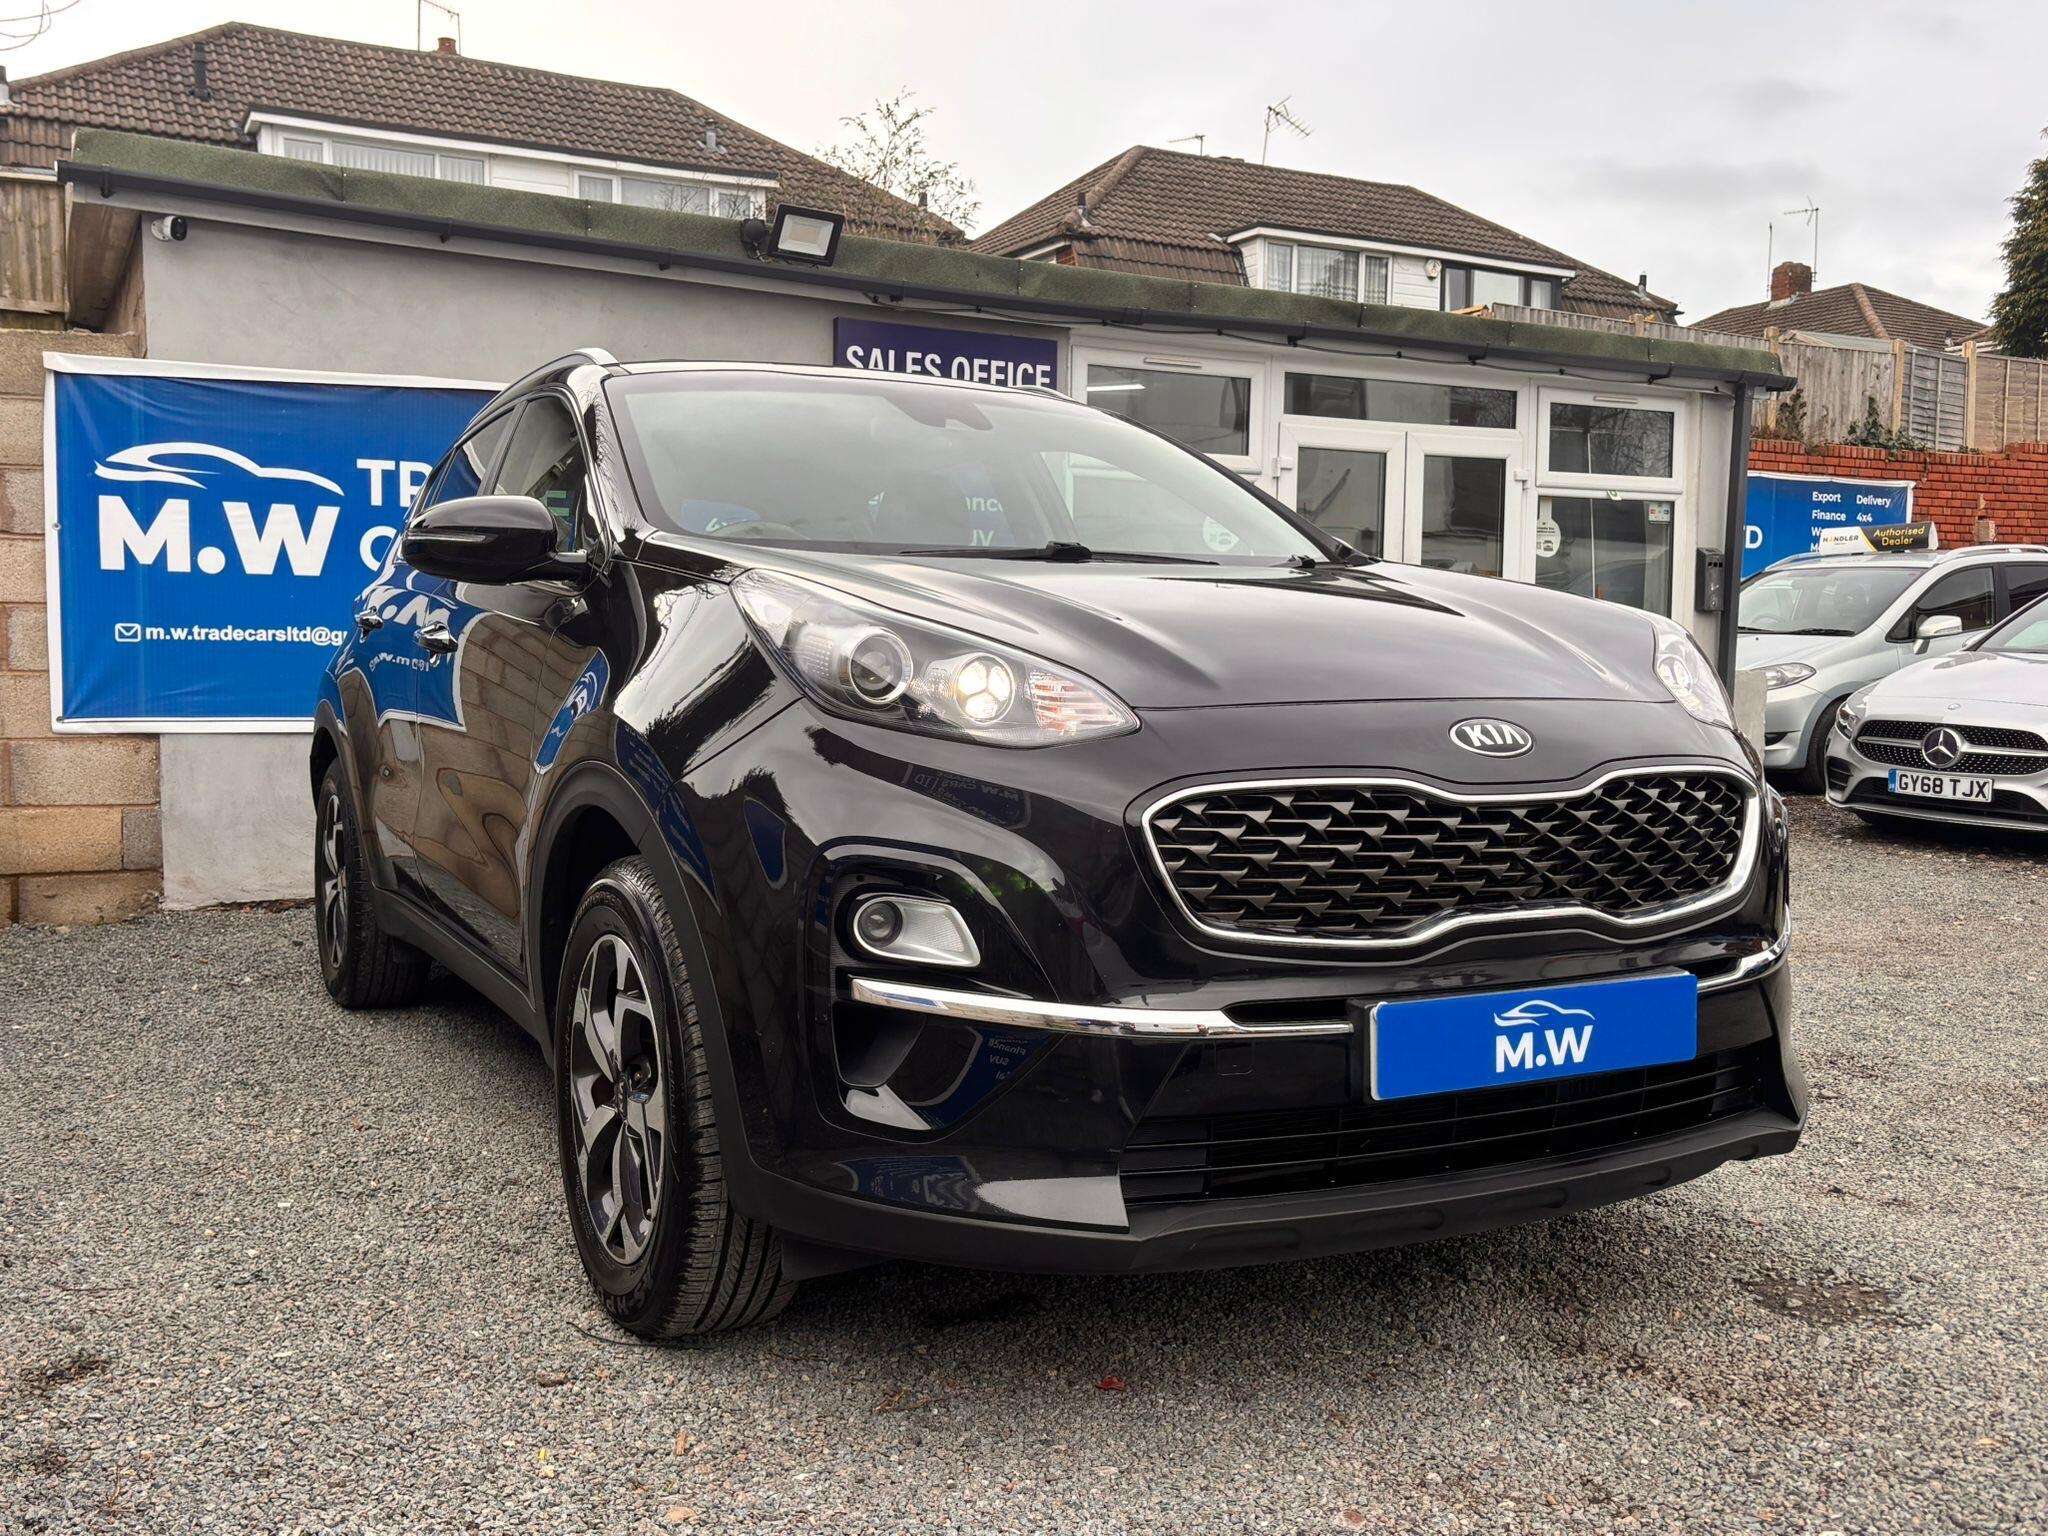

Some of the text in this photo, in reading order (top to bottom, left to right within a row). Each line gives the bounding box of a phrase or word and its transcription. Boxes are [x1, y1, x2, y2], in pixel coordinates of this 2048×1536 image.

[1812, 491, 1891, 507] Export Delivery
[1811, 509, 1873, 523] Finance 4x4
[98, 494, 341, 577] M.W
[1743, 524, 1763, 549] D
[1811, 526, 1821, 537] W
[1873, 526, 1925, 538] Authorised
[1881, 537, 1914, 546] Dealer
[1462, 724, 1526, 748] KIA
[1899, 774, 1988, 799] GY68 TJX
[1495, 1025, 1594, 1073] M.W
